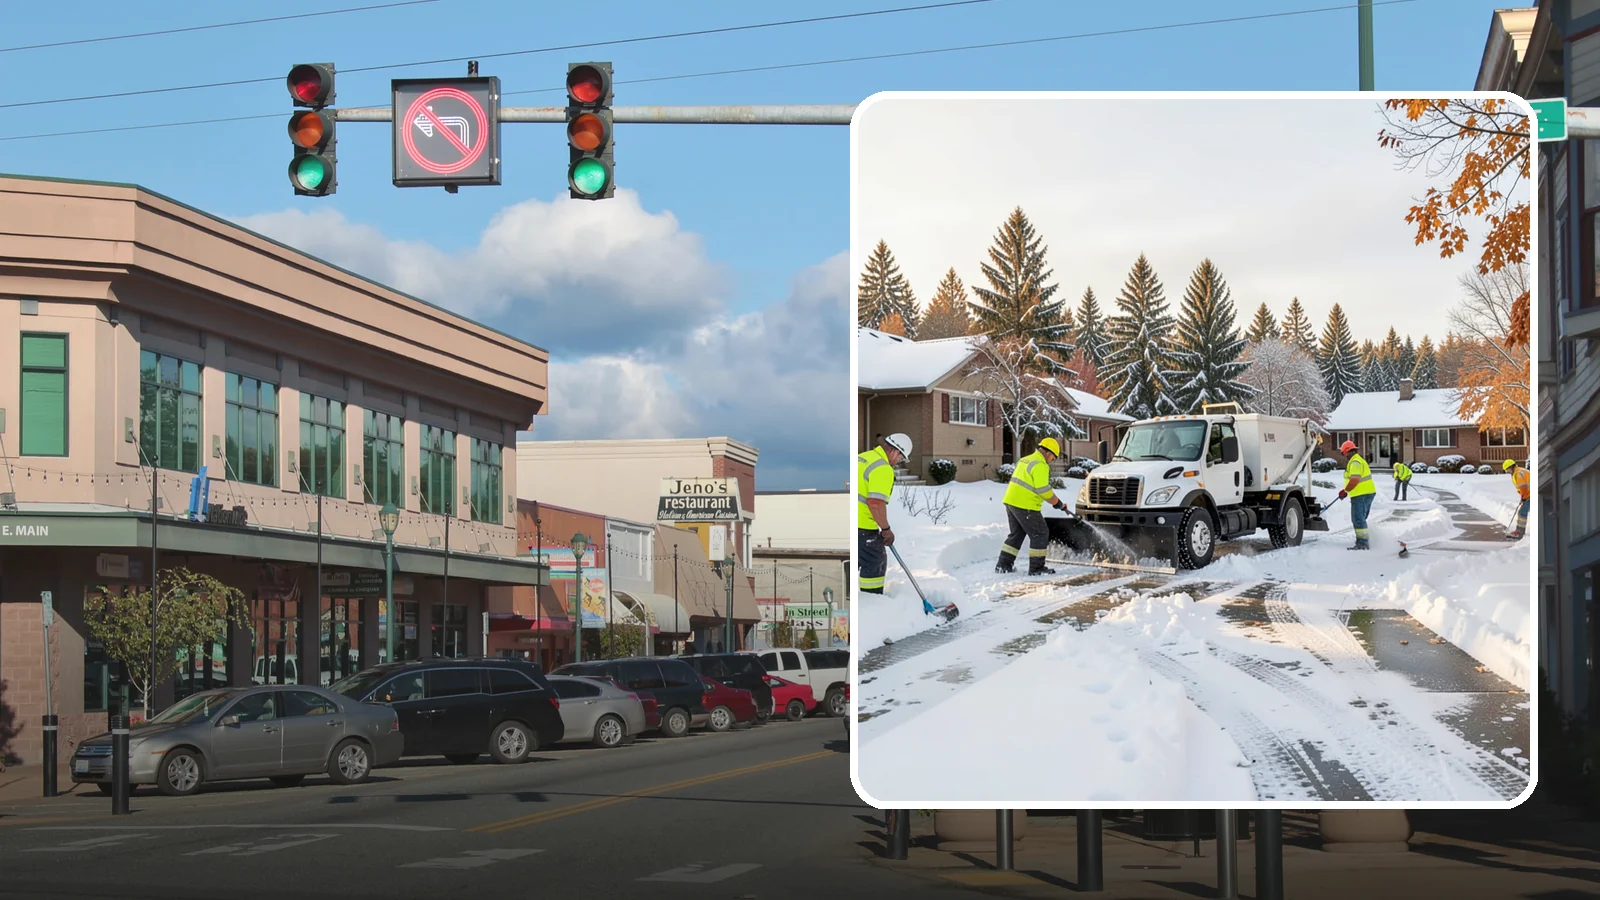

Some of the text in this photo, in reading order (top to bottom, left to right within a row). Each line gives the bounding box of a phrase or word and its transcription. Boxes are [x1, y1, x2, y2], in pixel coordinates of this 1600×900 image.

[670, 480, 727, 494] Jeno's
[665, 496, 731, 509] restaurant
[658, 509, 681, 520] Italian
[686, 509, 715, 519] American
[715, 509, 738, 519] Cuisine
[2, 525, 49, 536] E. MAIN
[797, 607, 829, 617] Street
